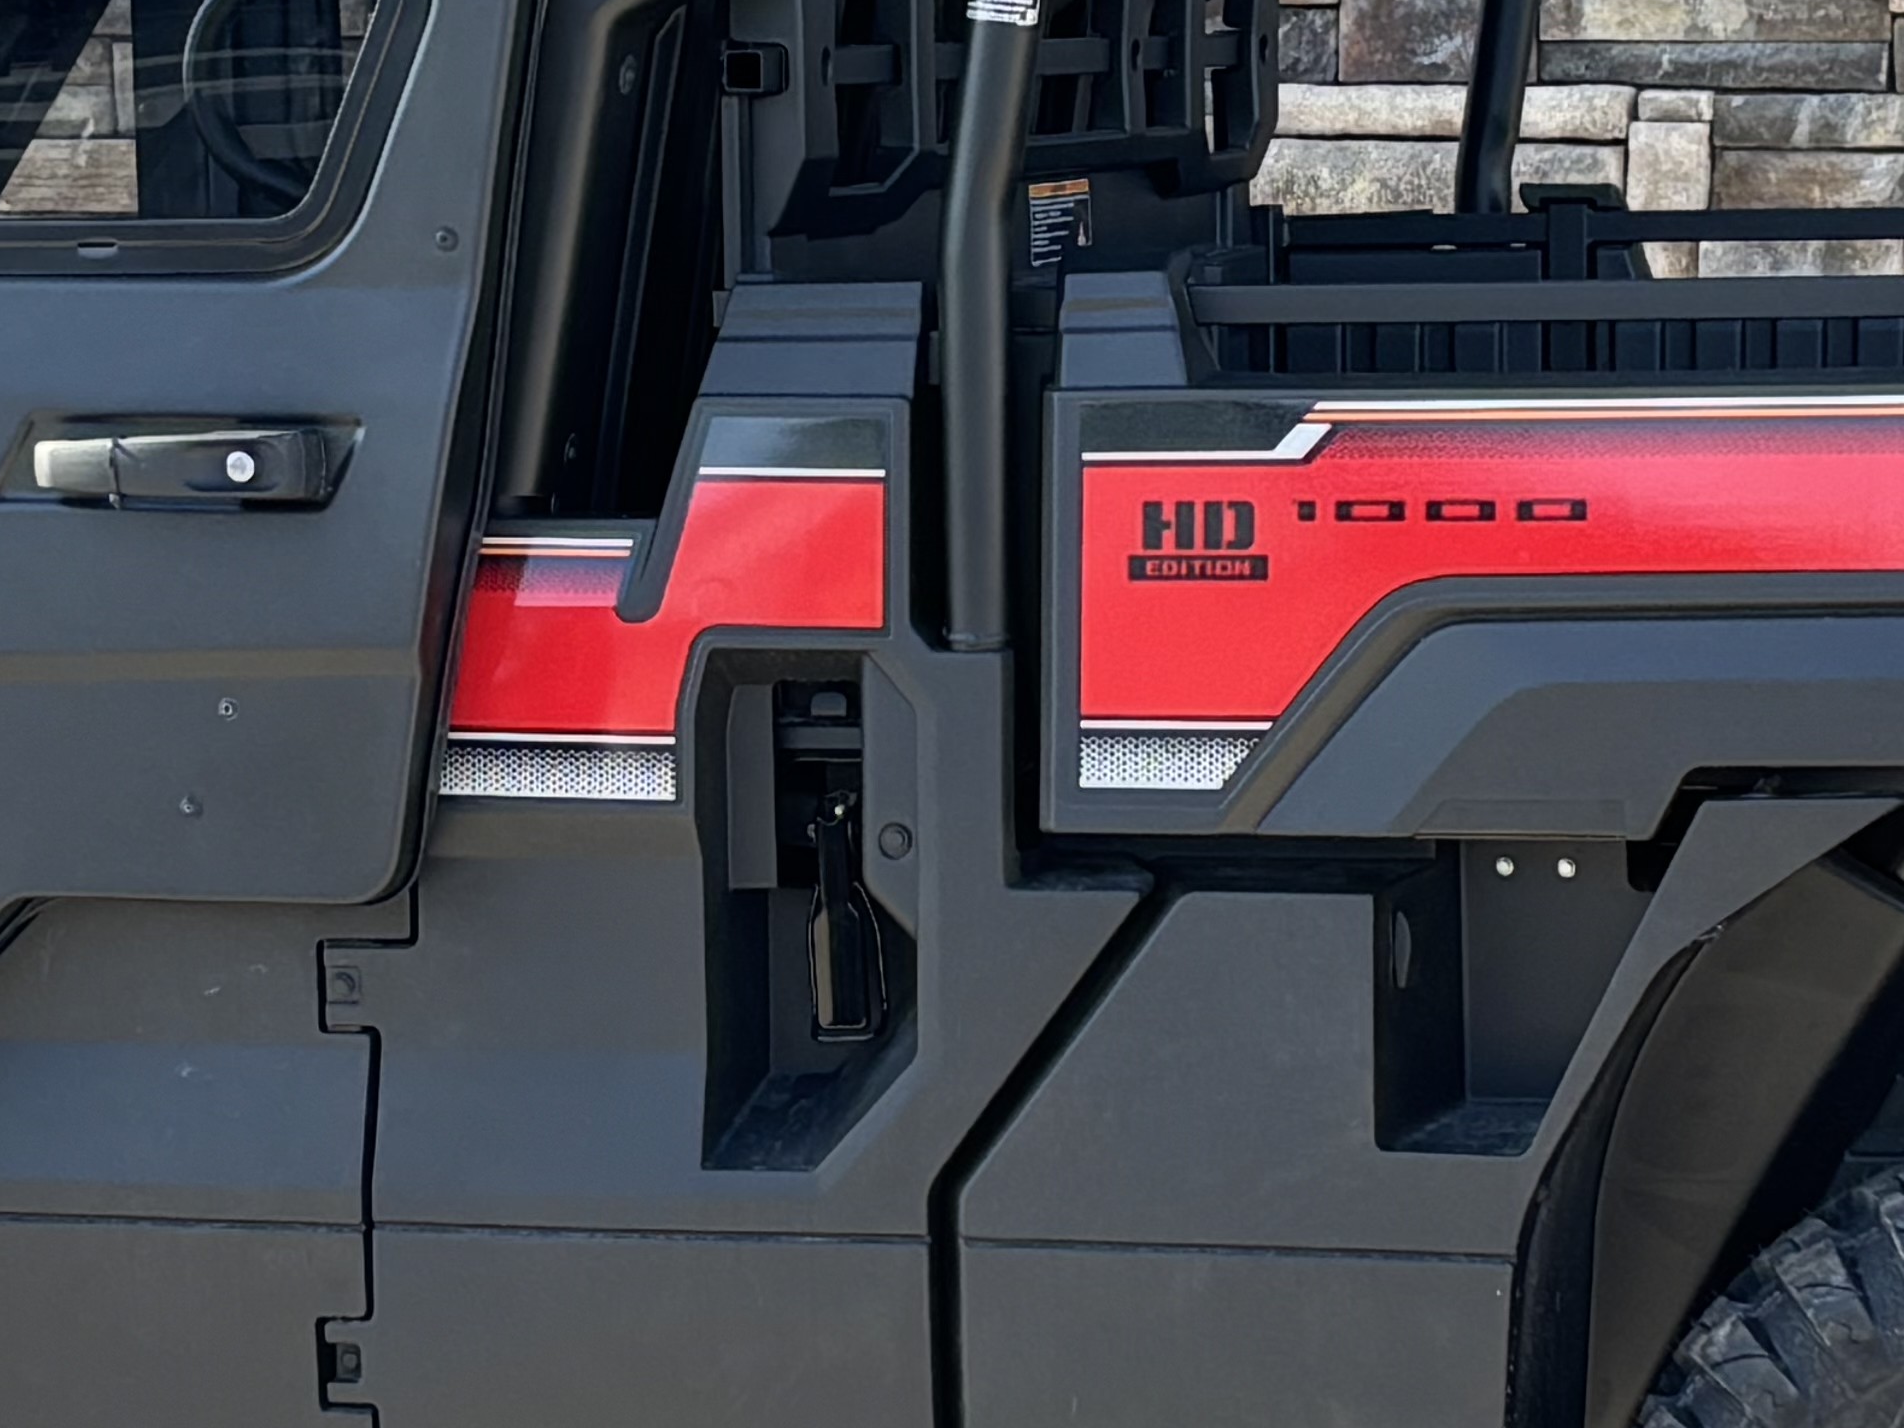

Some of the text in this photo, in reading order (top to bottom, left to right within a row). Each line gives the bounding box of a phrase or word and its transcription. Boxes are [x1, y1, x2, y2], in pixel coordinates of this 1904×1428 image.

[1293, 498, 1588, 523] 1000
[1142, 500, 1255, 551] HD
[1145, 558, 1251, 577] EDITION
